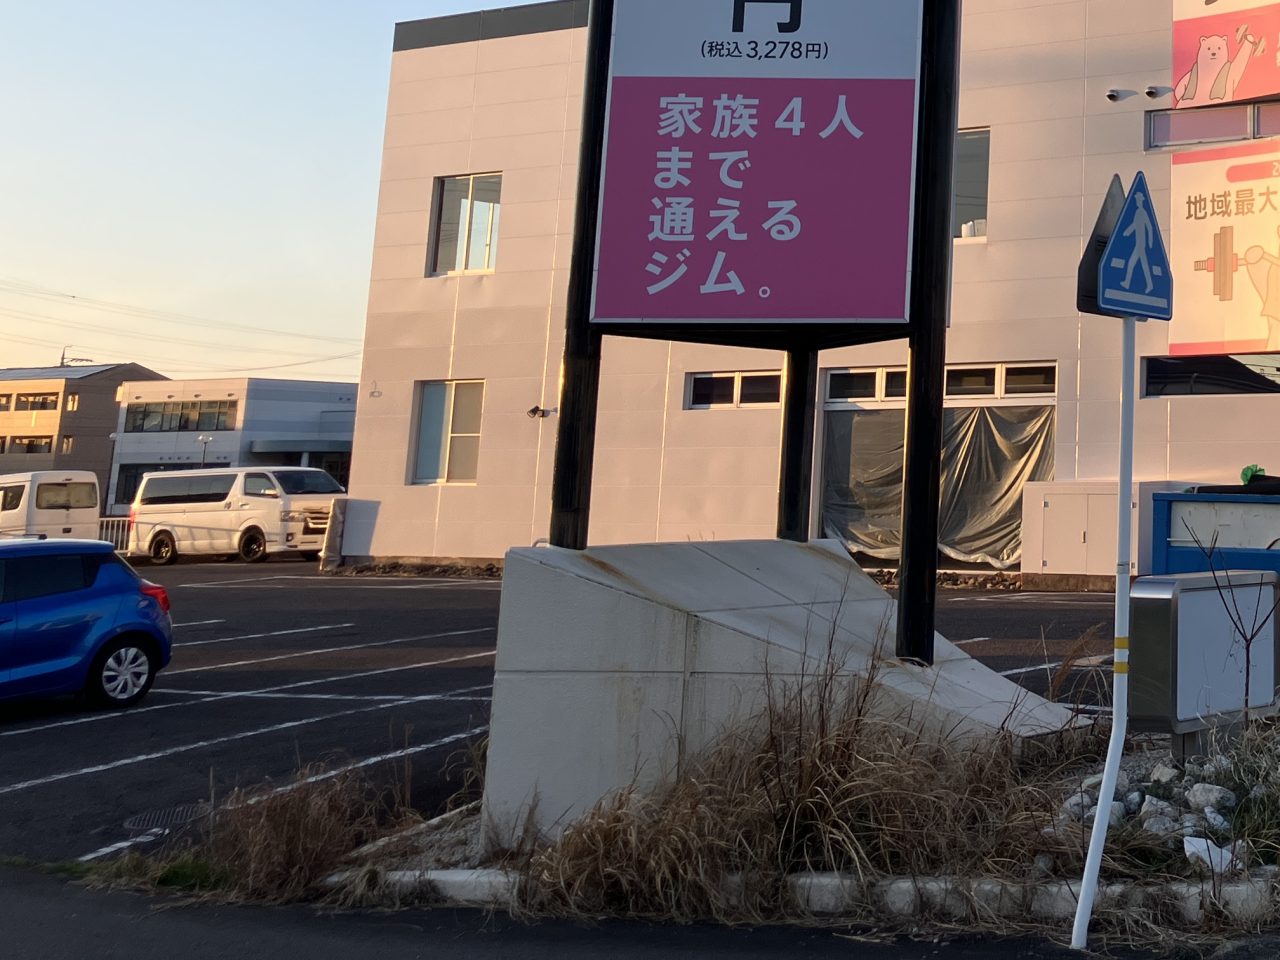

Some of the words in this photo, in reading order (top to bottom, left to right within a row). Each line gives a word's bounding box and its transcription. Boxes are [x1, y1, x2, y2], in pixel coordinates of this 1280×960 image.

[657, 94, 864, 139] 家族4人
[653, 147, 751, 189] まで
[648, 197, 802, 241] 通える
[645, 249, 771, 295] ジム。
